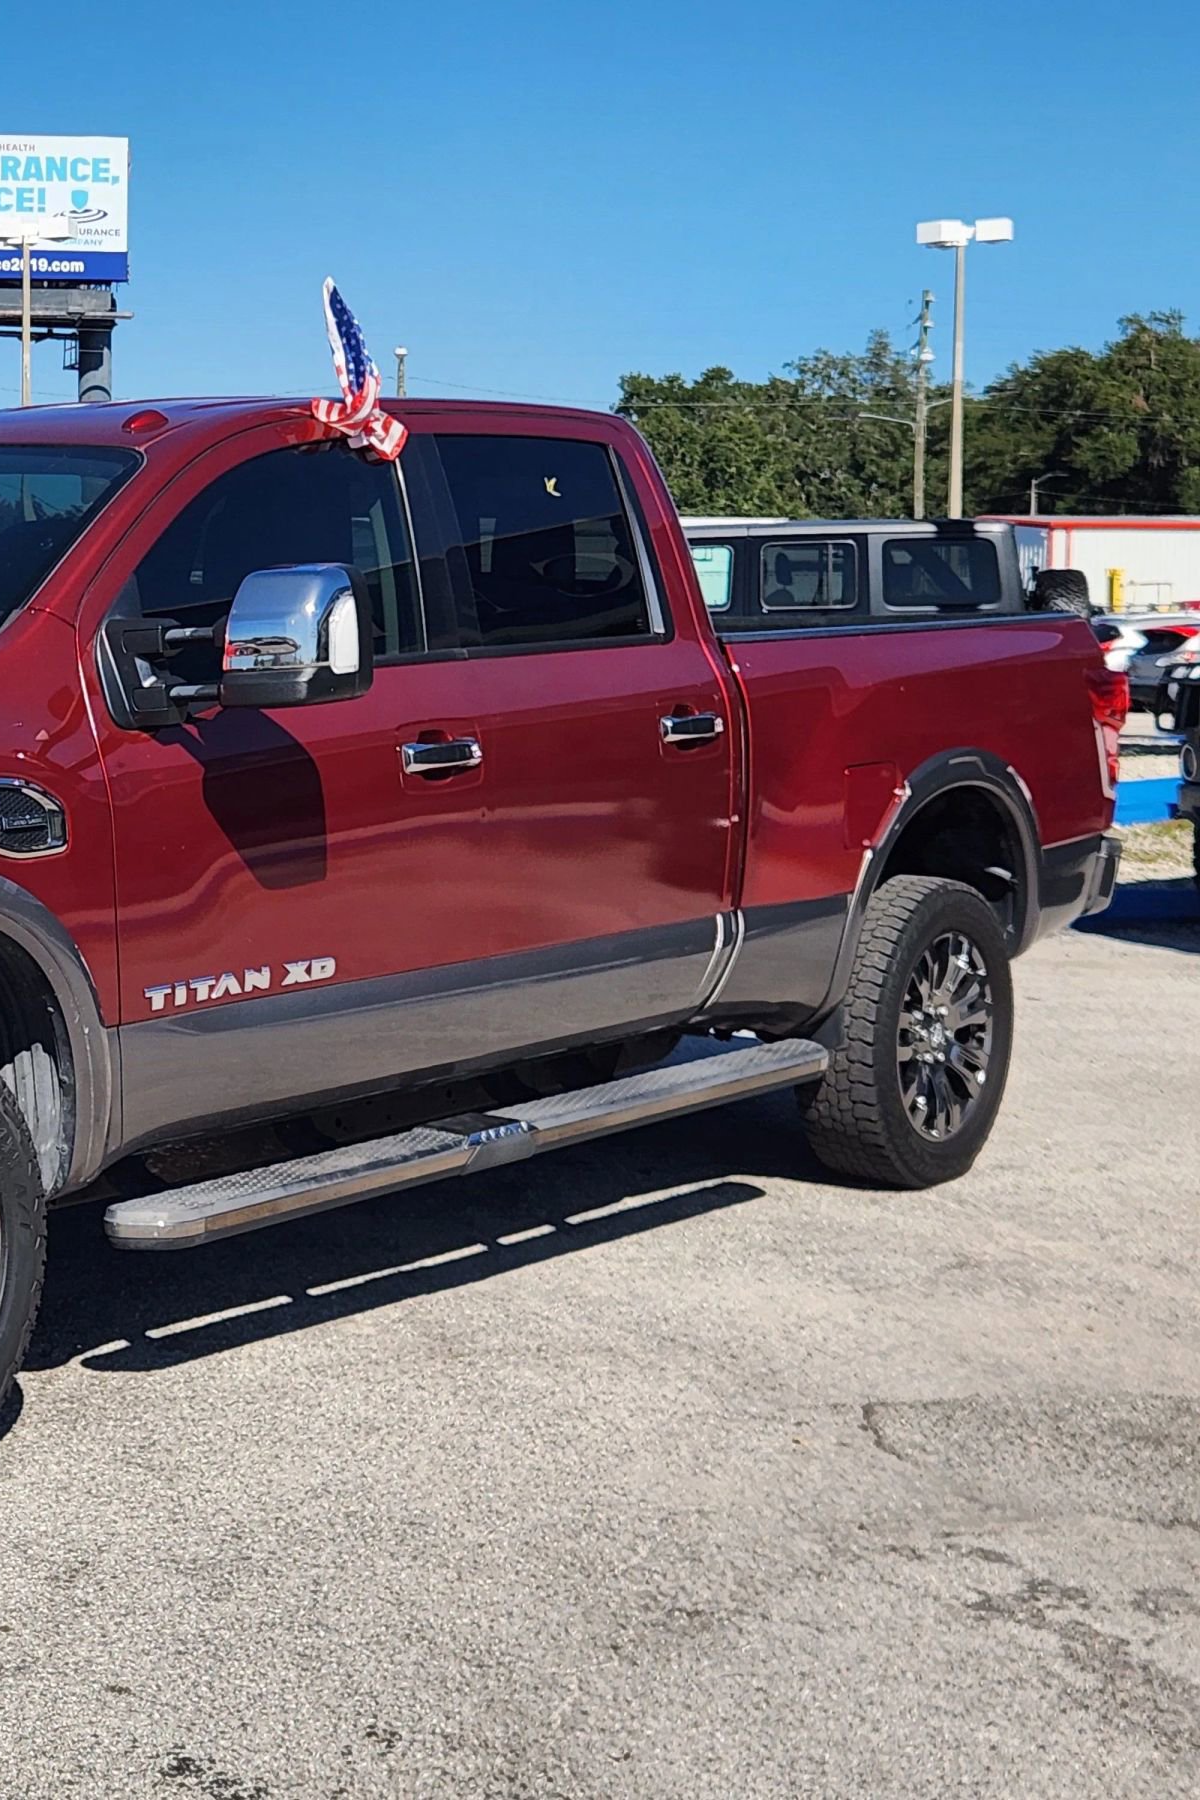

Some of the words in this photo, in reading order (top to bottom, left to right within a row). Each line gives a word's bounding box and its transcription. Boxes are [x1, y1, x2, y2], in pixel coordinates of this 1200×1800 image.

[0, 143, 35, 152] HEALTH
[79, 228, 121, 237] URANCE
[143, 965, 272, 1012] TITAN
[280, 956, 337, 987] XD
